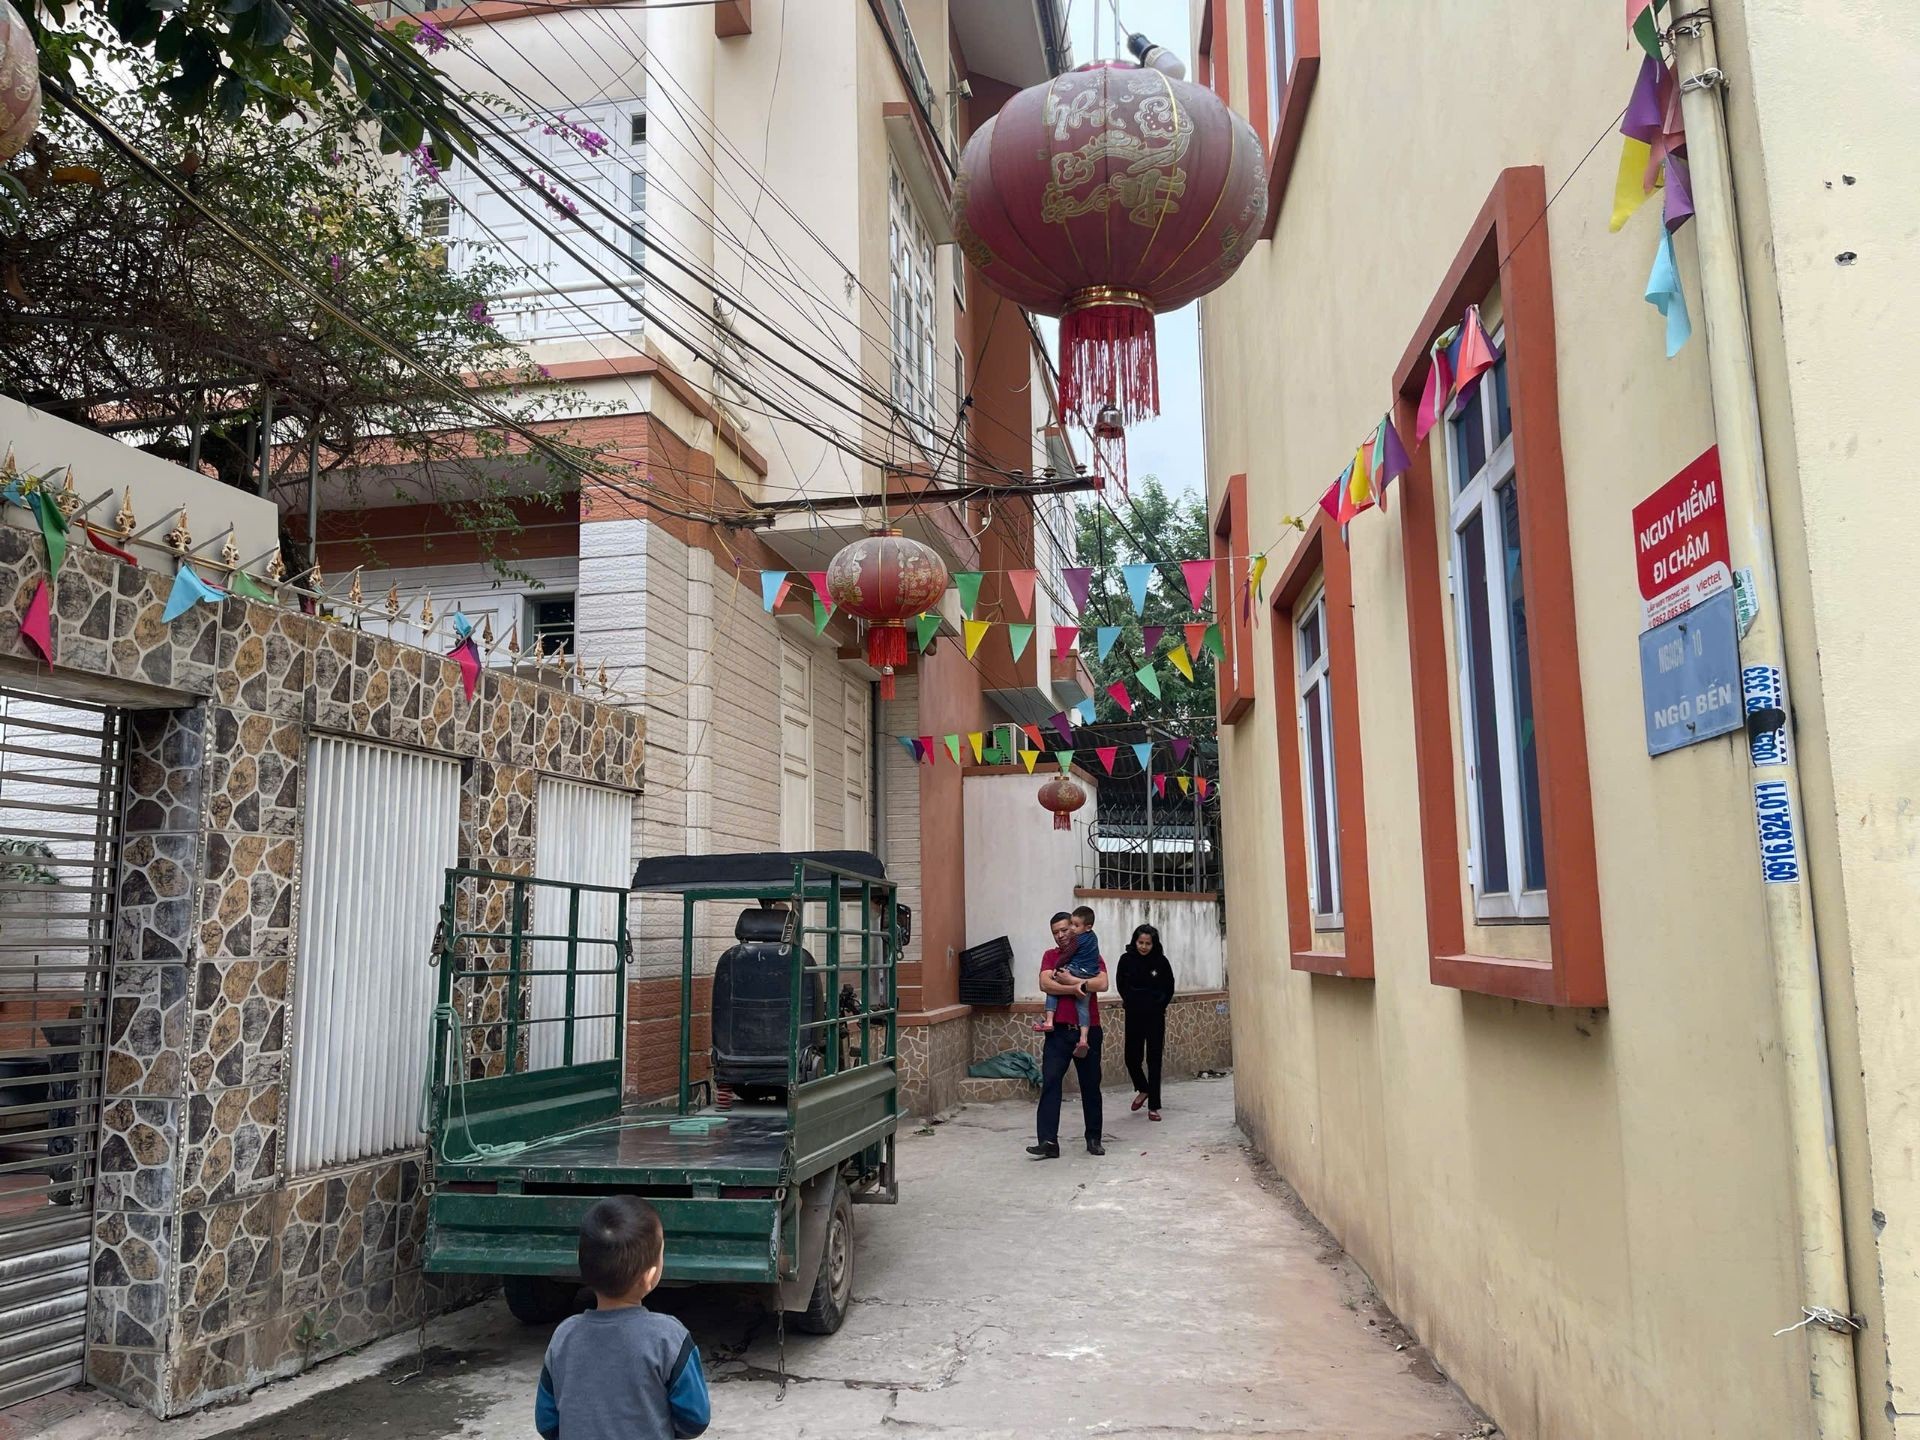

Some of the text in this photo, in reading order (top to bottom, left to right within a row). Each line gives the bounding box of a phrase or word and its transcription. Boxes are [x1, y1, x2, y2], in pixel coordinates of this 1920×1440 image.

[1640, 480, 1717, 553] NGUY HIỂM!
[1653, 531, 1710, 584] ĐI CHẬM
[1696, 570, 1722, 592] viettel
[1692, 629, 1703, 657] 10
[1654, 678, 1732, 729] NGÕ BẾN
[1757, 783, 1798, 881] 0916.824.011
